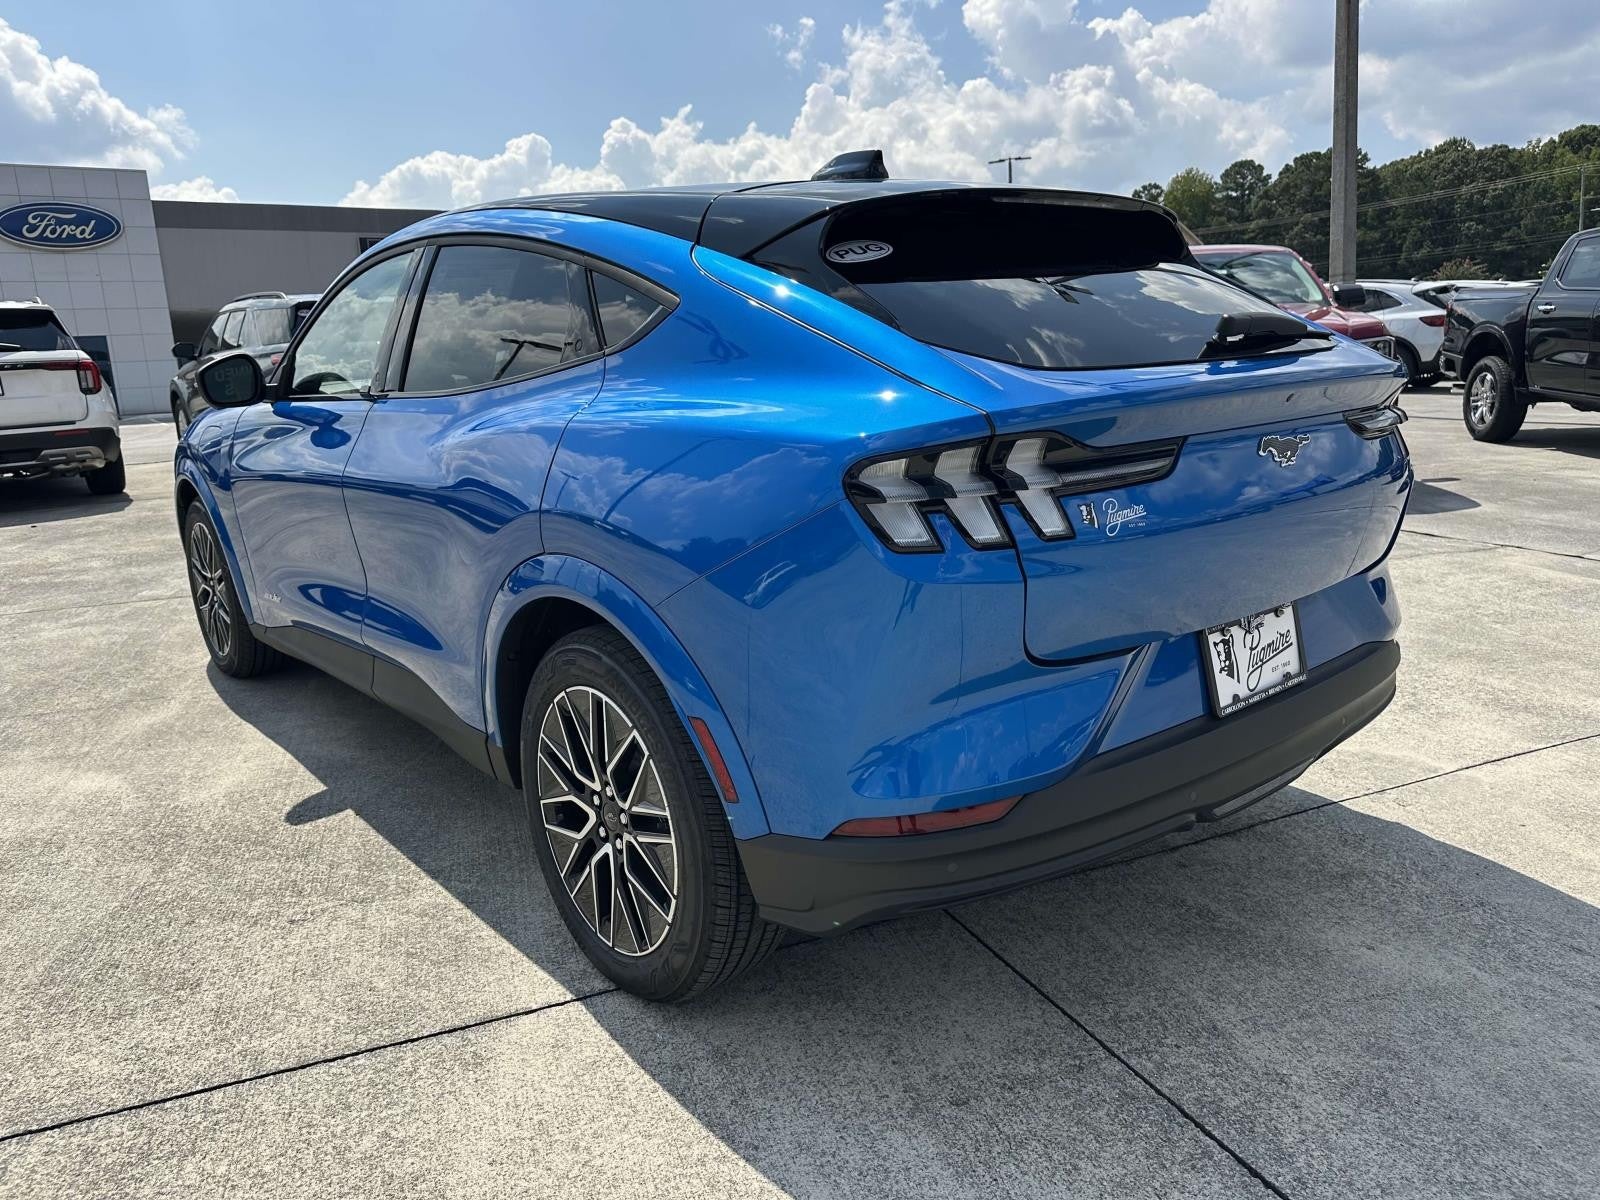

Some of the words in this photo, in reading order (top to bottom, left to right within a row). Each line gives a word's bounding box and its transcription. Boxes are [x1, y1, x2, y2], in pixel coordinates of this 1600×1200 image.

[22, 211, 96, 239] Ford
[832, 243, 887, 259] PUG
[1102, 497, 1147, 537] Pugmire
[1243, 625, 1293, 692] Pugmire
